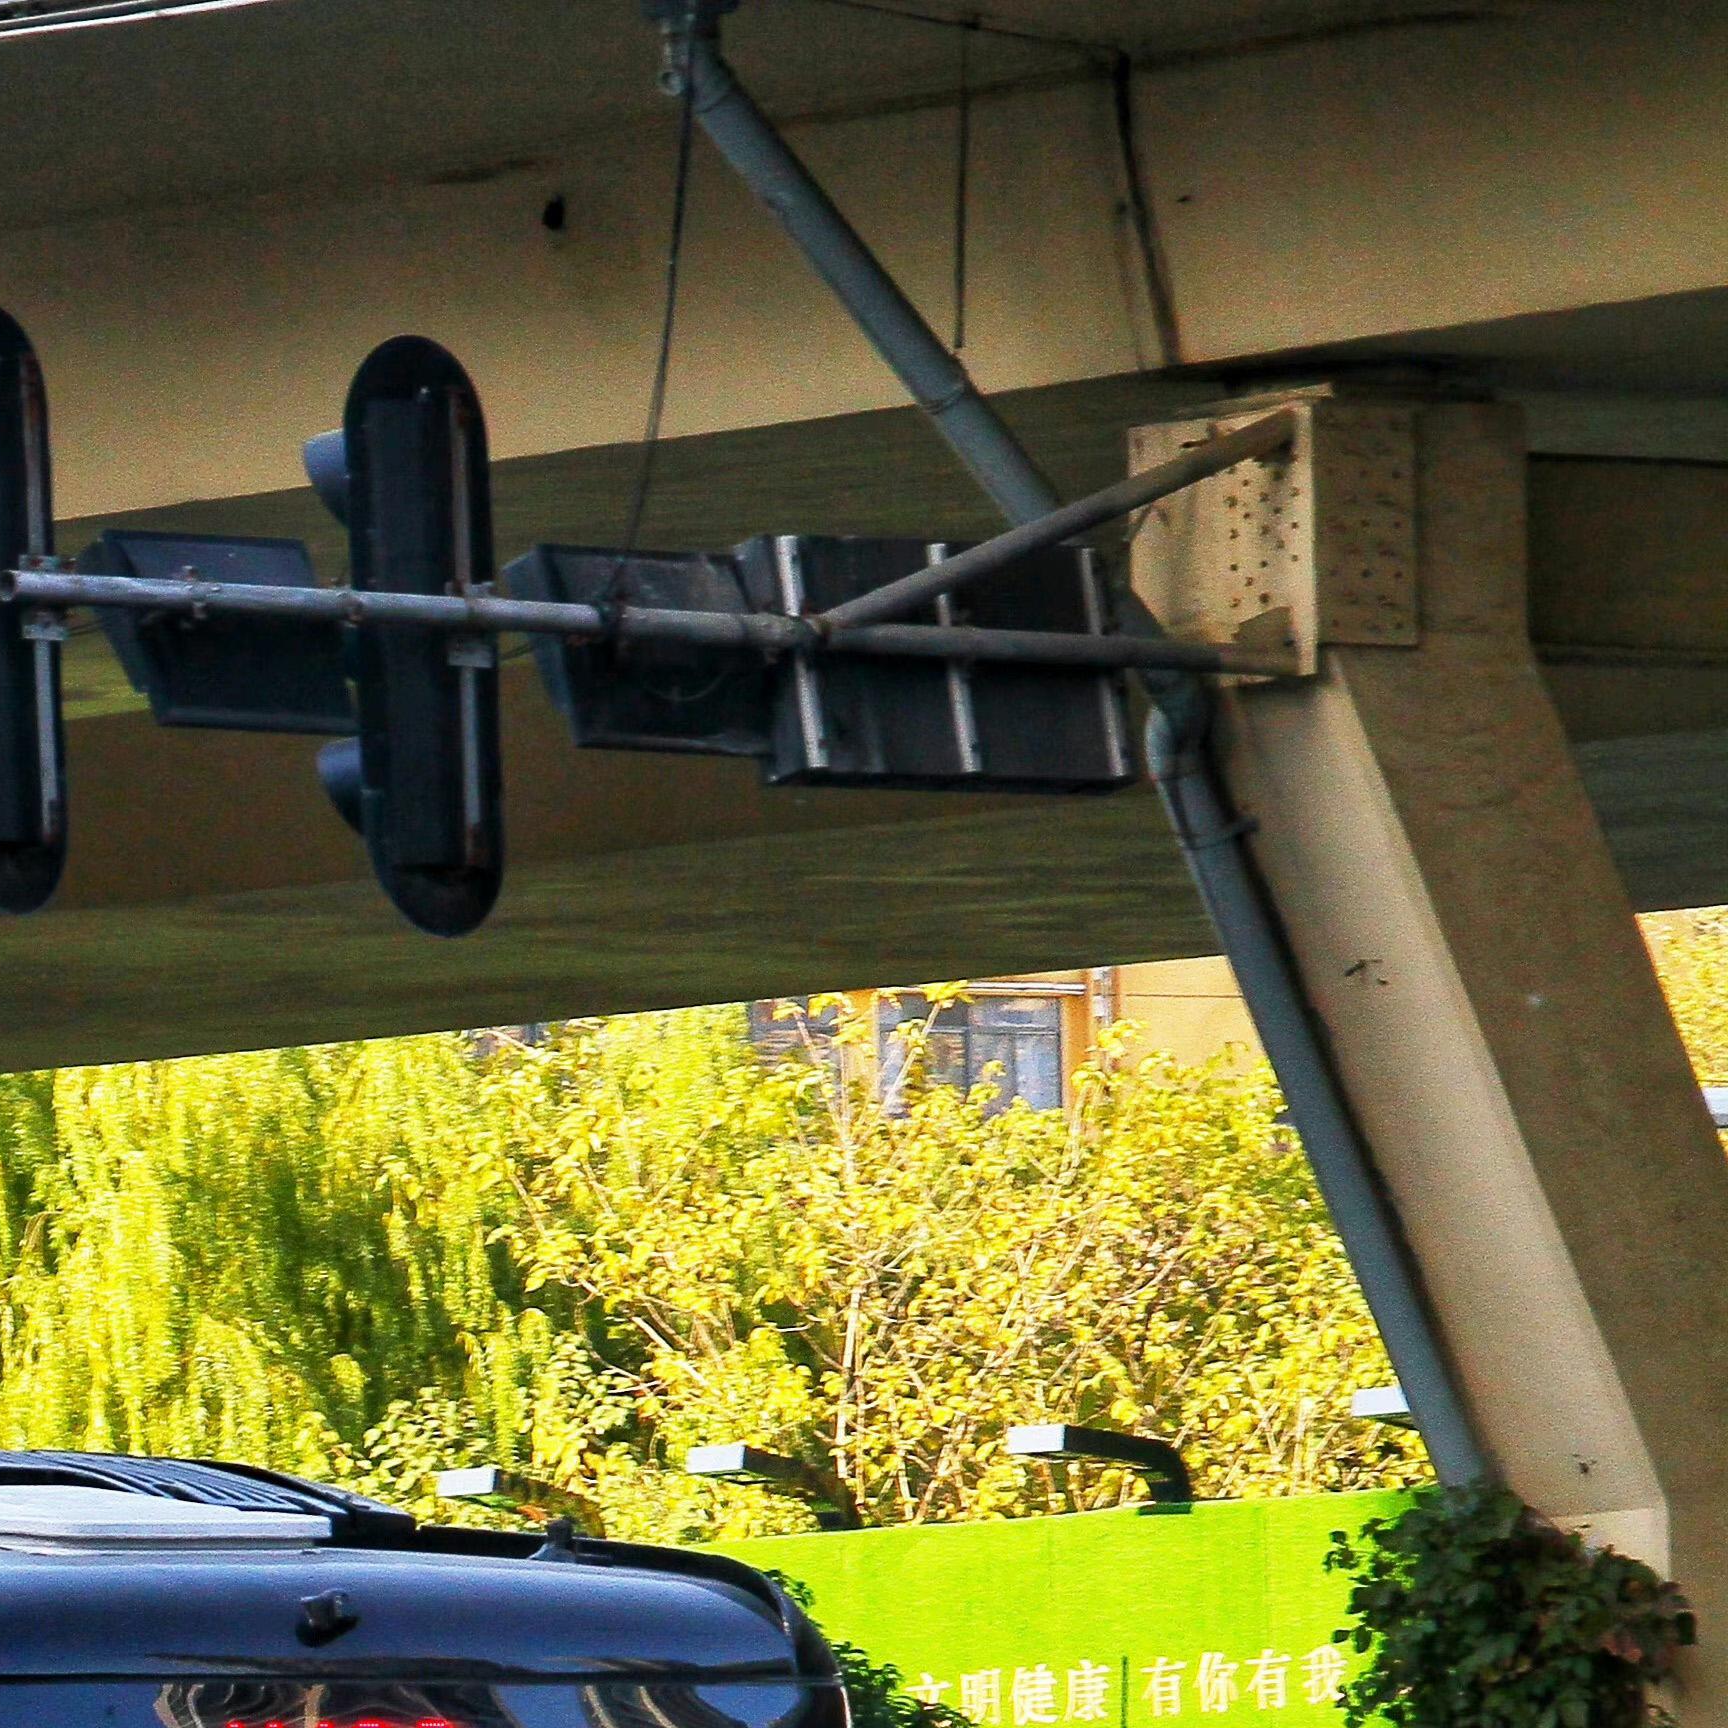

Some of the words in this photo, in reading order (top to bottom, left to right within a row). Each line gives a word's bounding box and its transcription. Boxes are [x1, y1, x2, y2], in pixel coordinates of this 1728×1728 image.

[905, 1659, 1111, 1727] 文明健康
[1141, 1645, 1347, 1717] 有你有我
